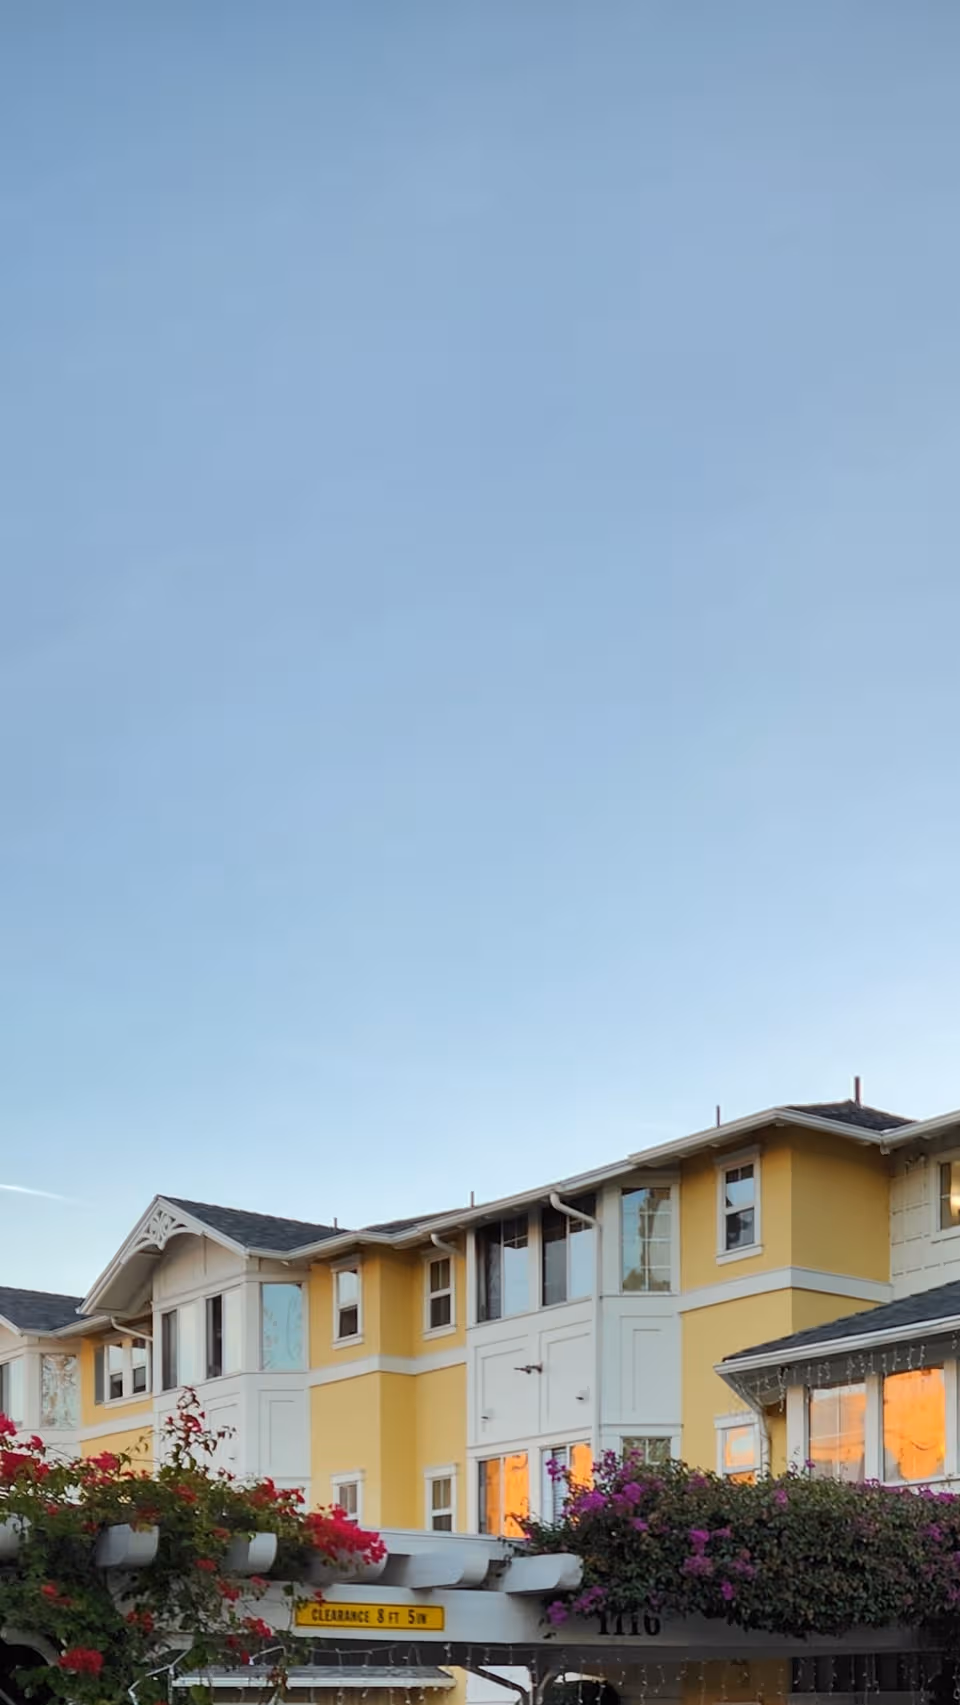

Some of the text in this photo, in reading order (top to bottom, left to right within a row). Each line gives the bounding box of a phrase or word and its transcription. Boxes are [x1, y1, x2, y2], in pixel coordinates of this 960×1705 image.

[311, 1608, 369, 1623] CLEARANCE
[377, 1608, 385, 1624] 8
[389, 1611, 400, 1624] FT
